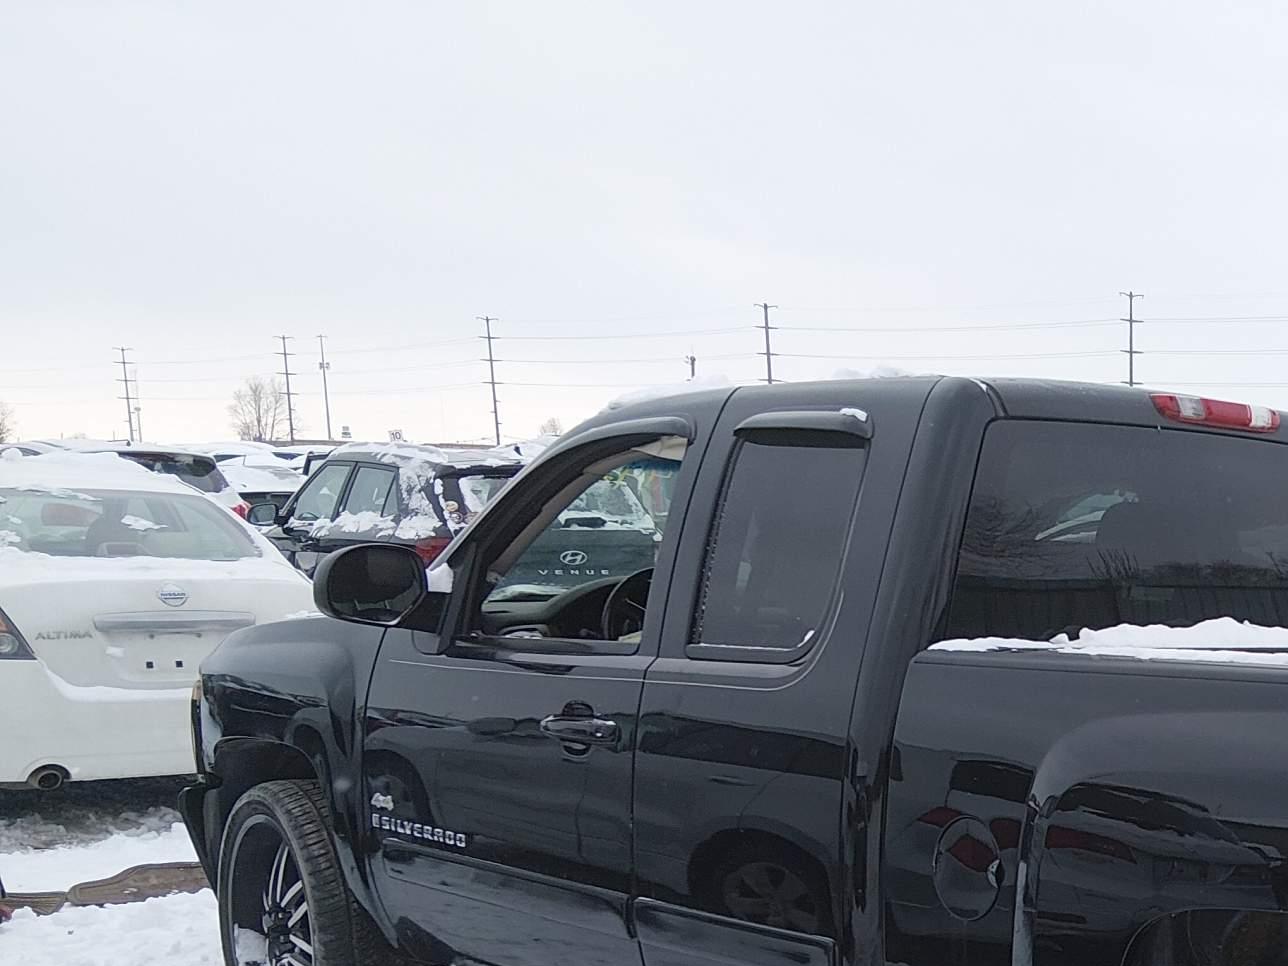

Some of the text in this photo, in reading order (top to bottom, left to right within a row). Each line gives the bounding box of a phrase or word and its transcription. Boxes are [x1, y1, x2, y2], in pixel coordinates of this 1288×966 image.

[391, 431, 401, 440] 10
[35, 630, 93, 640] ALTIMA
[381, 816, 466, 848] SILVERADO
